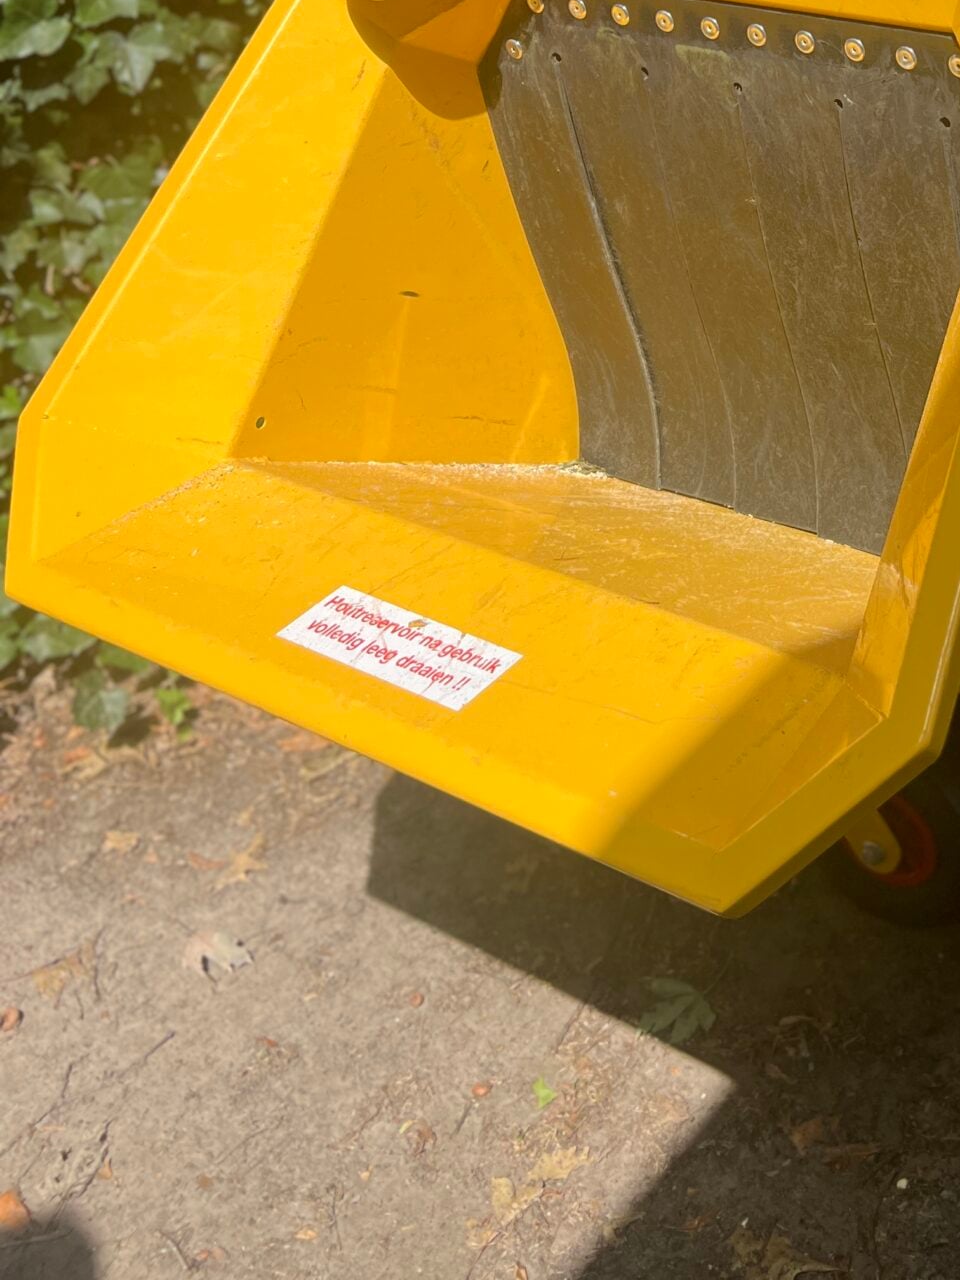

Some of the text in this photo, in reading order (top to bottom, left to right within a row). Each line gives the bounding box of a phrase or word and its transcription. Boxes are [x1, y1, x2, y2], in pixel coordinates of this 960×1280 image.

[307, 619, 365, 651] volledig
[363, 641, 398, 665] leeg
[396, 655, 455, 687] draaien
[324, 595, 502, 674] Houtreservoir na gebruik
